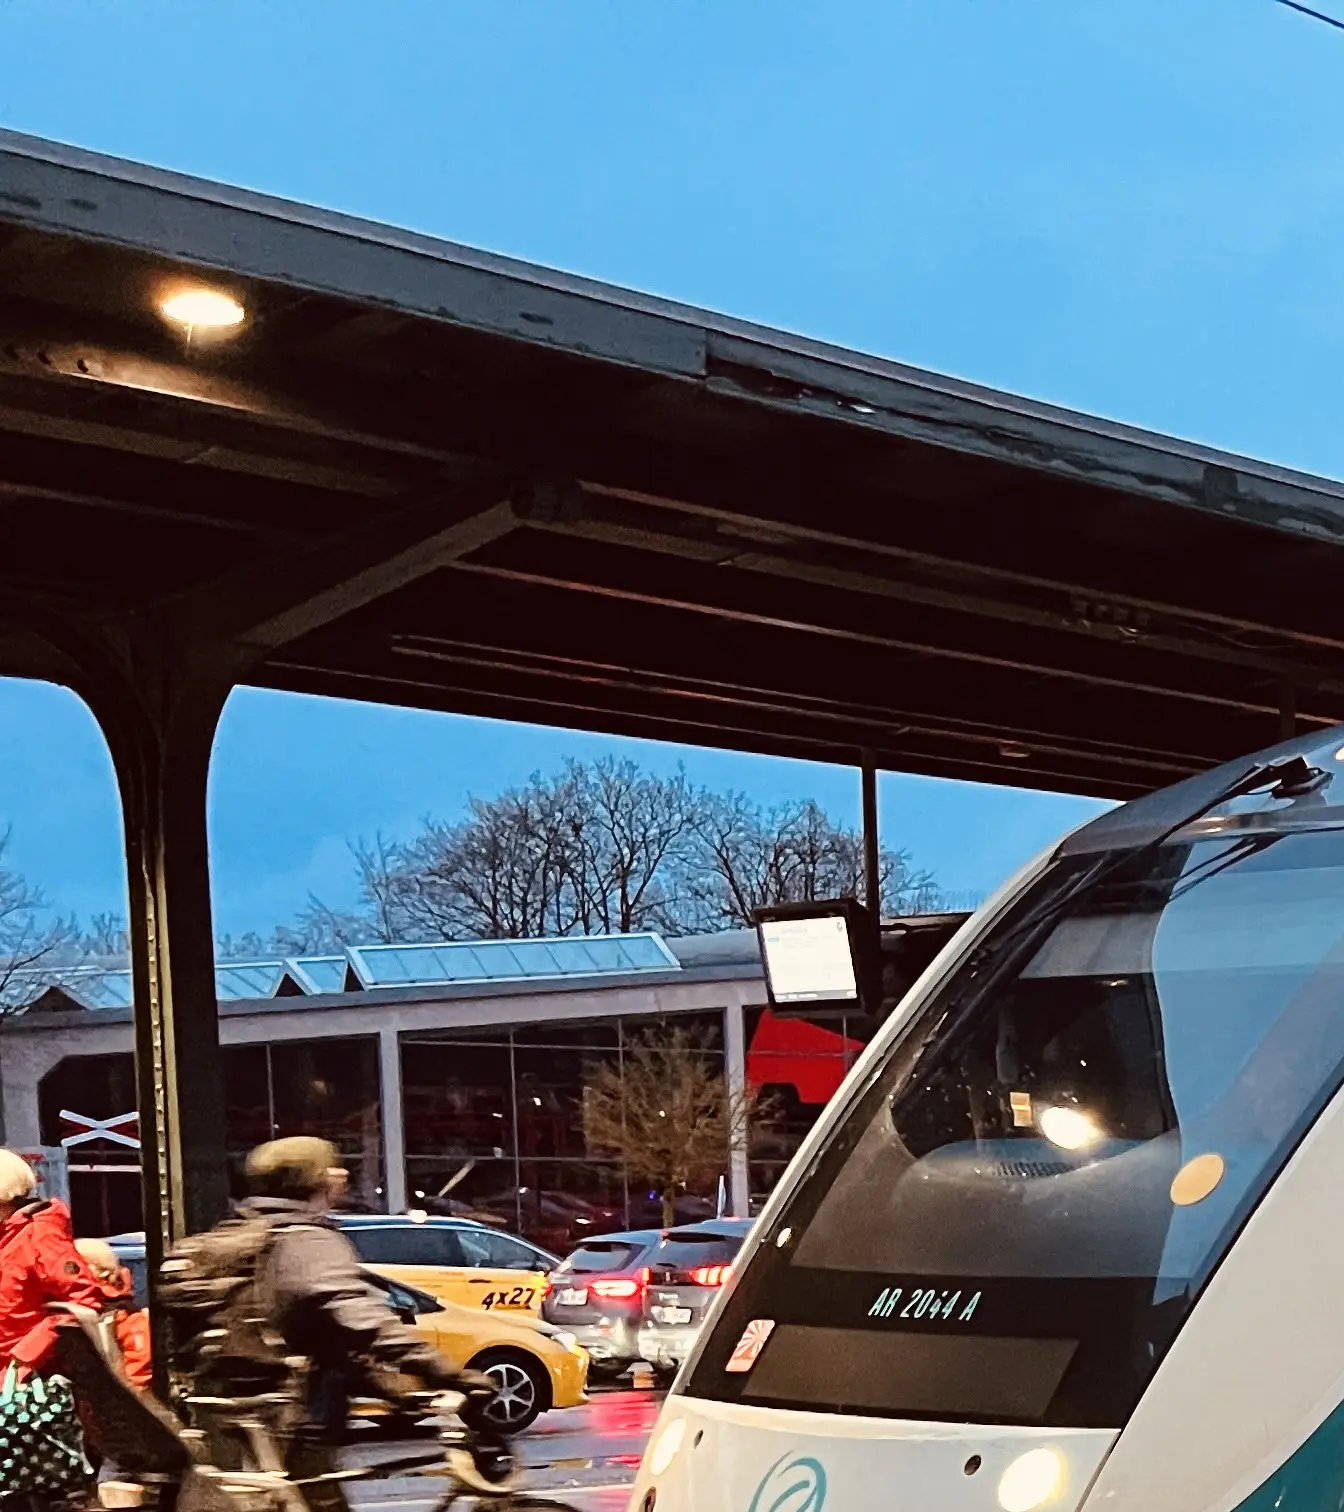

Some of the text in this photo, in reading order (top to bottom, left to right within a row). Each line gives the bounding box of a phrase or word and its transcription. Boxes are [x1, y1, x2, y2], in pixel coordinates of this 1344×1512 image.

[868, 1287, 982, 1321] AR 2044 A
